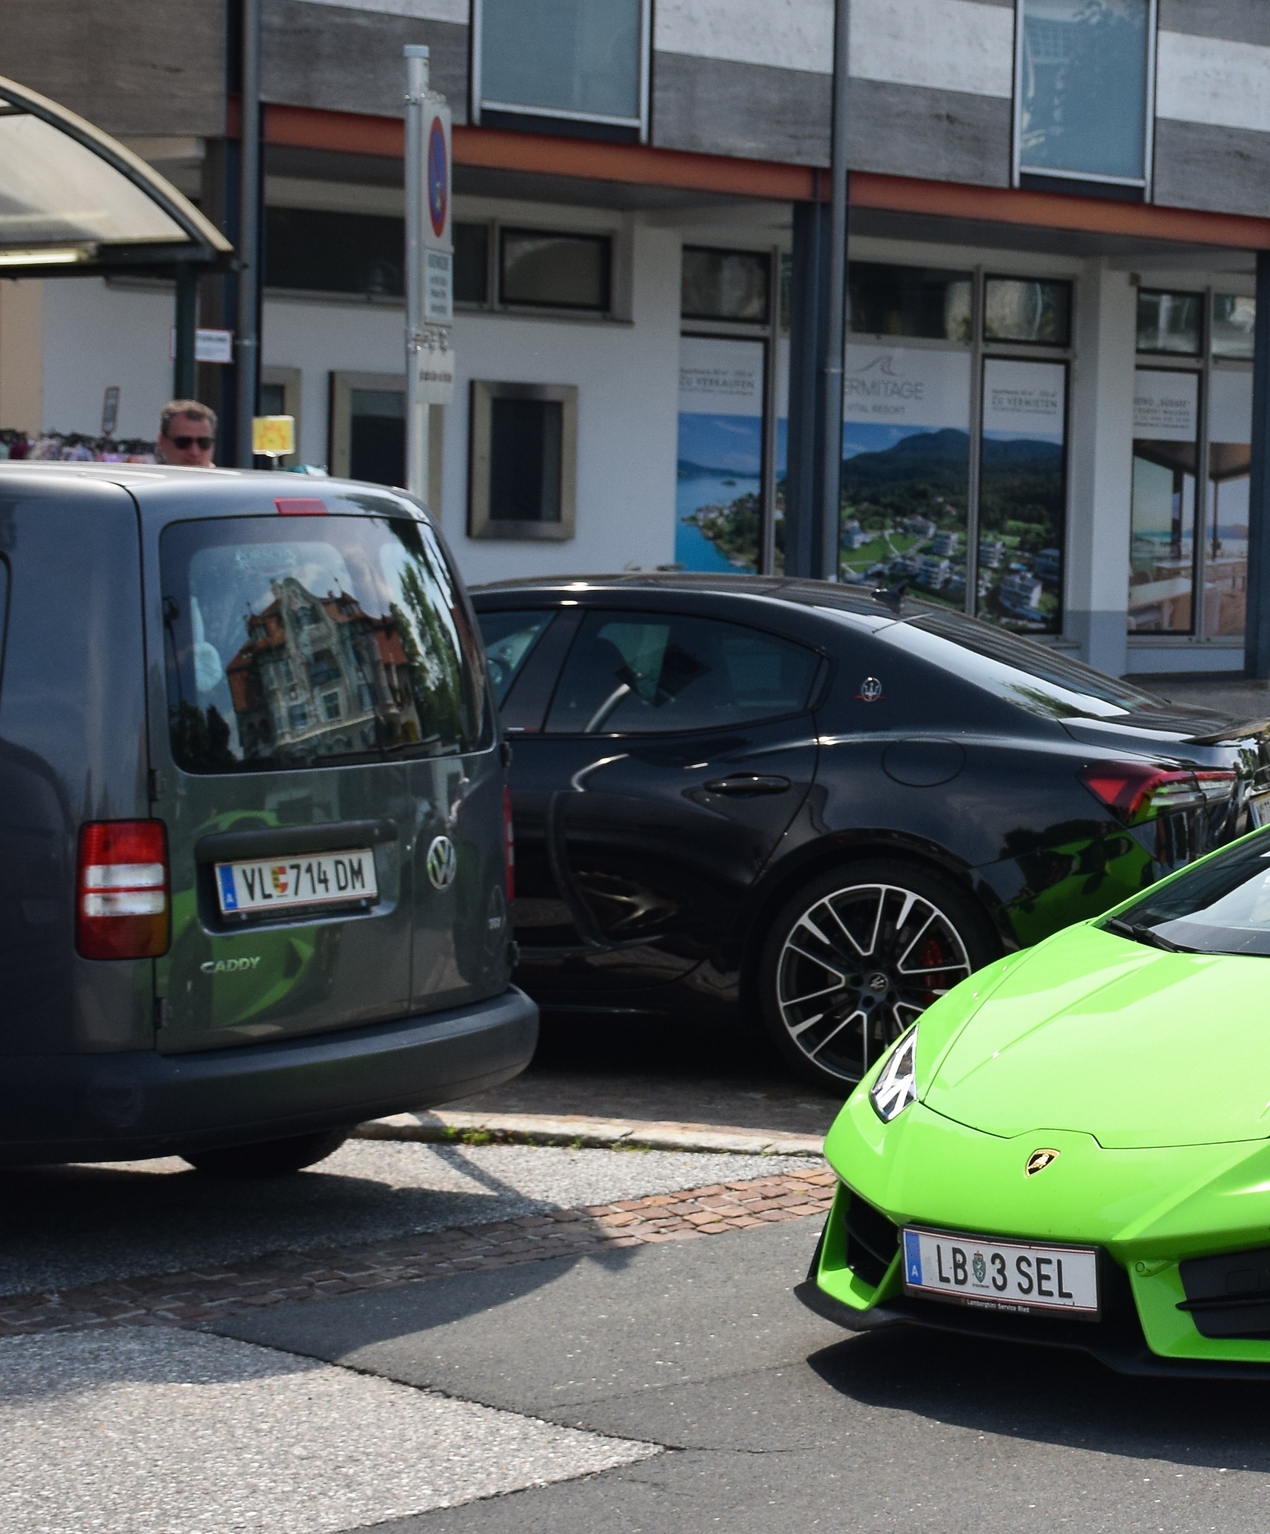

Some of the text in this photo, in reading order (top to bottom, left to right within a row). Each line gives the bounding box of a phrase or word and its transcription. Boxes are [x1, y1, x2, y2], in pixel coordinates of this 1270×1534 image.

[243, 857, 366, 901] VL 714 DM
[200, 955, 261, 974] CADDY
[911, 1265, 919, 1277] A
[936, 1243, 1073, 1299] LB 3 SEL
[966, 1299, 1030, 1313] Lamborghini Service Ried
